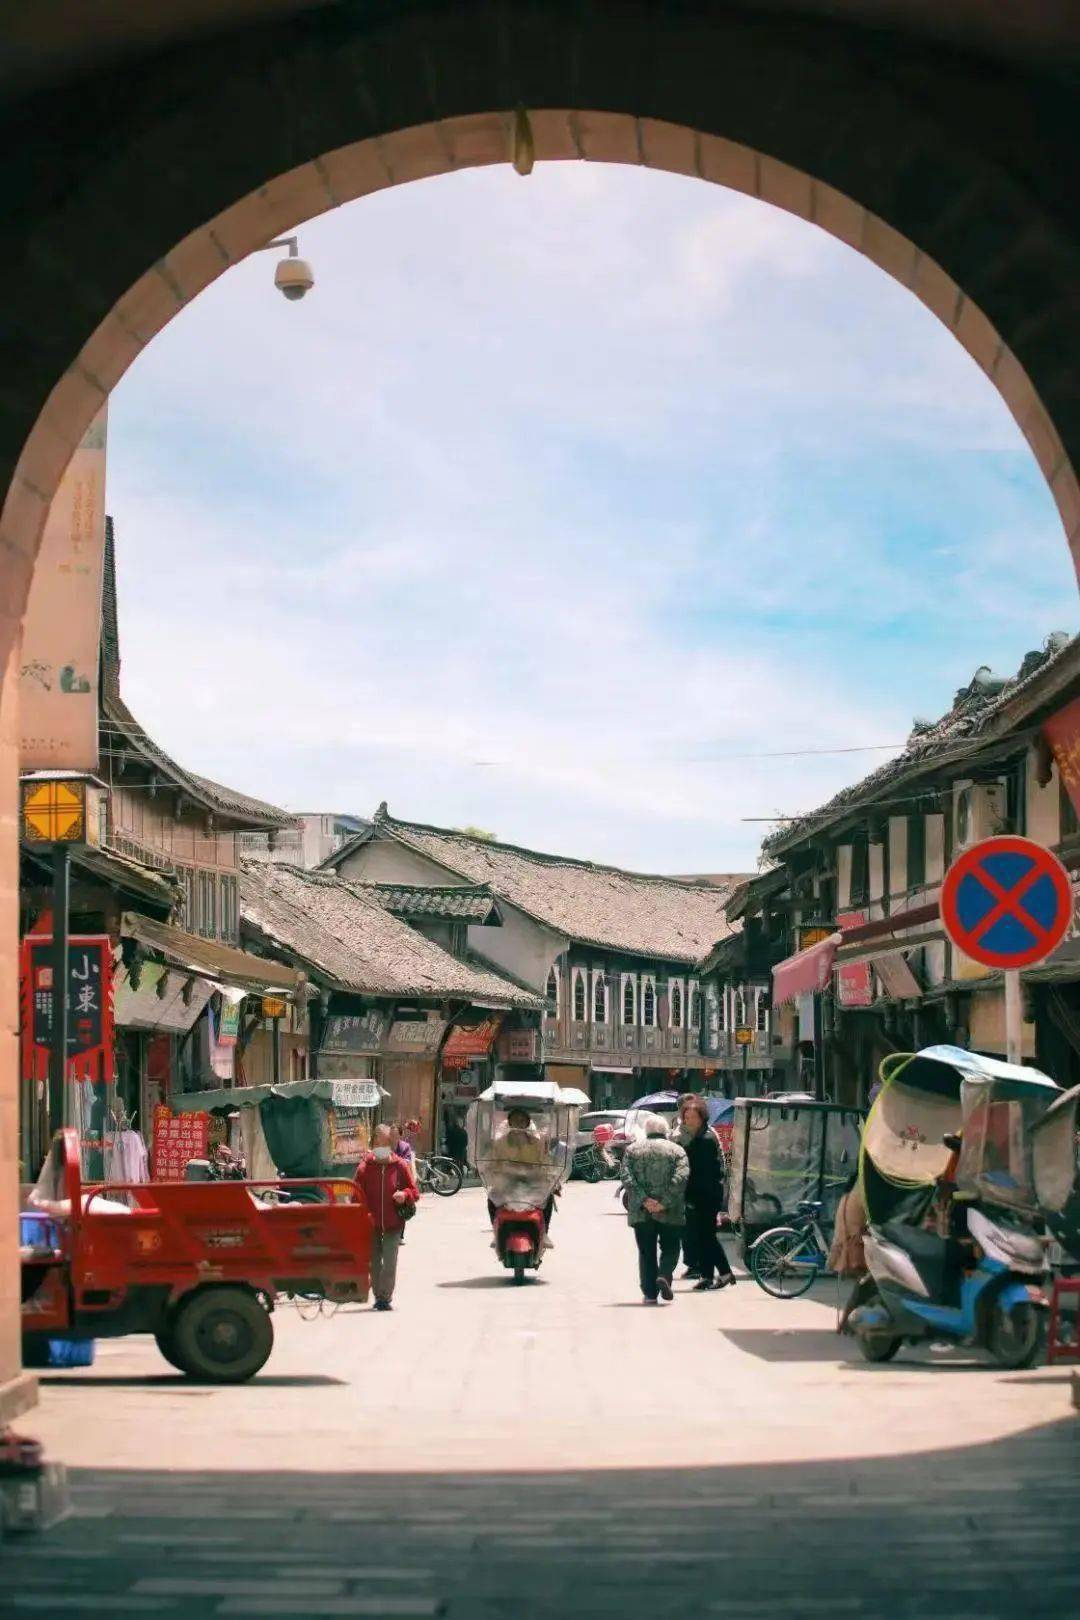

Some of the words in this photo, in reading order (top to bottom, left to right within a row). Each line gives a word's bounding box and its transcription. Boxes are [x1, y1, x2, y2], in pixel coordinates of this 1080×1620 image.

[71, 954, 99, 1012] 小東
[157, 1119, 204, 1129] 房屋买卖
[157, 1129, 203, 1139] 房屋出租
[157, 1149, 204, 1158] 代办过户
[156, 1158, 189, 1168] 职业介
